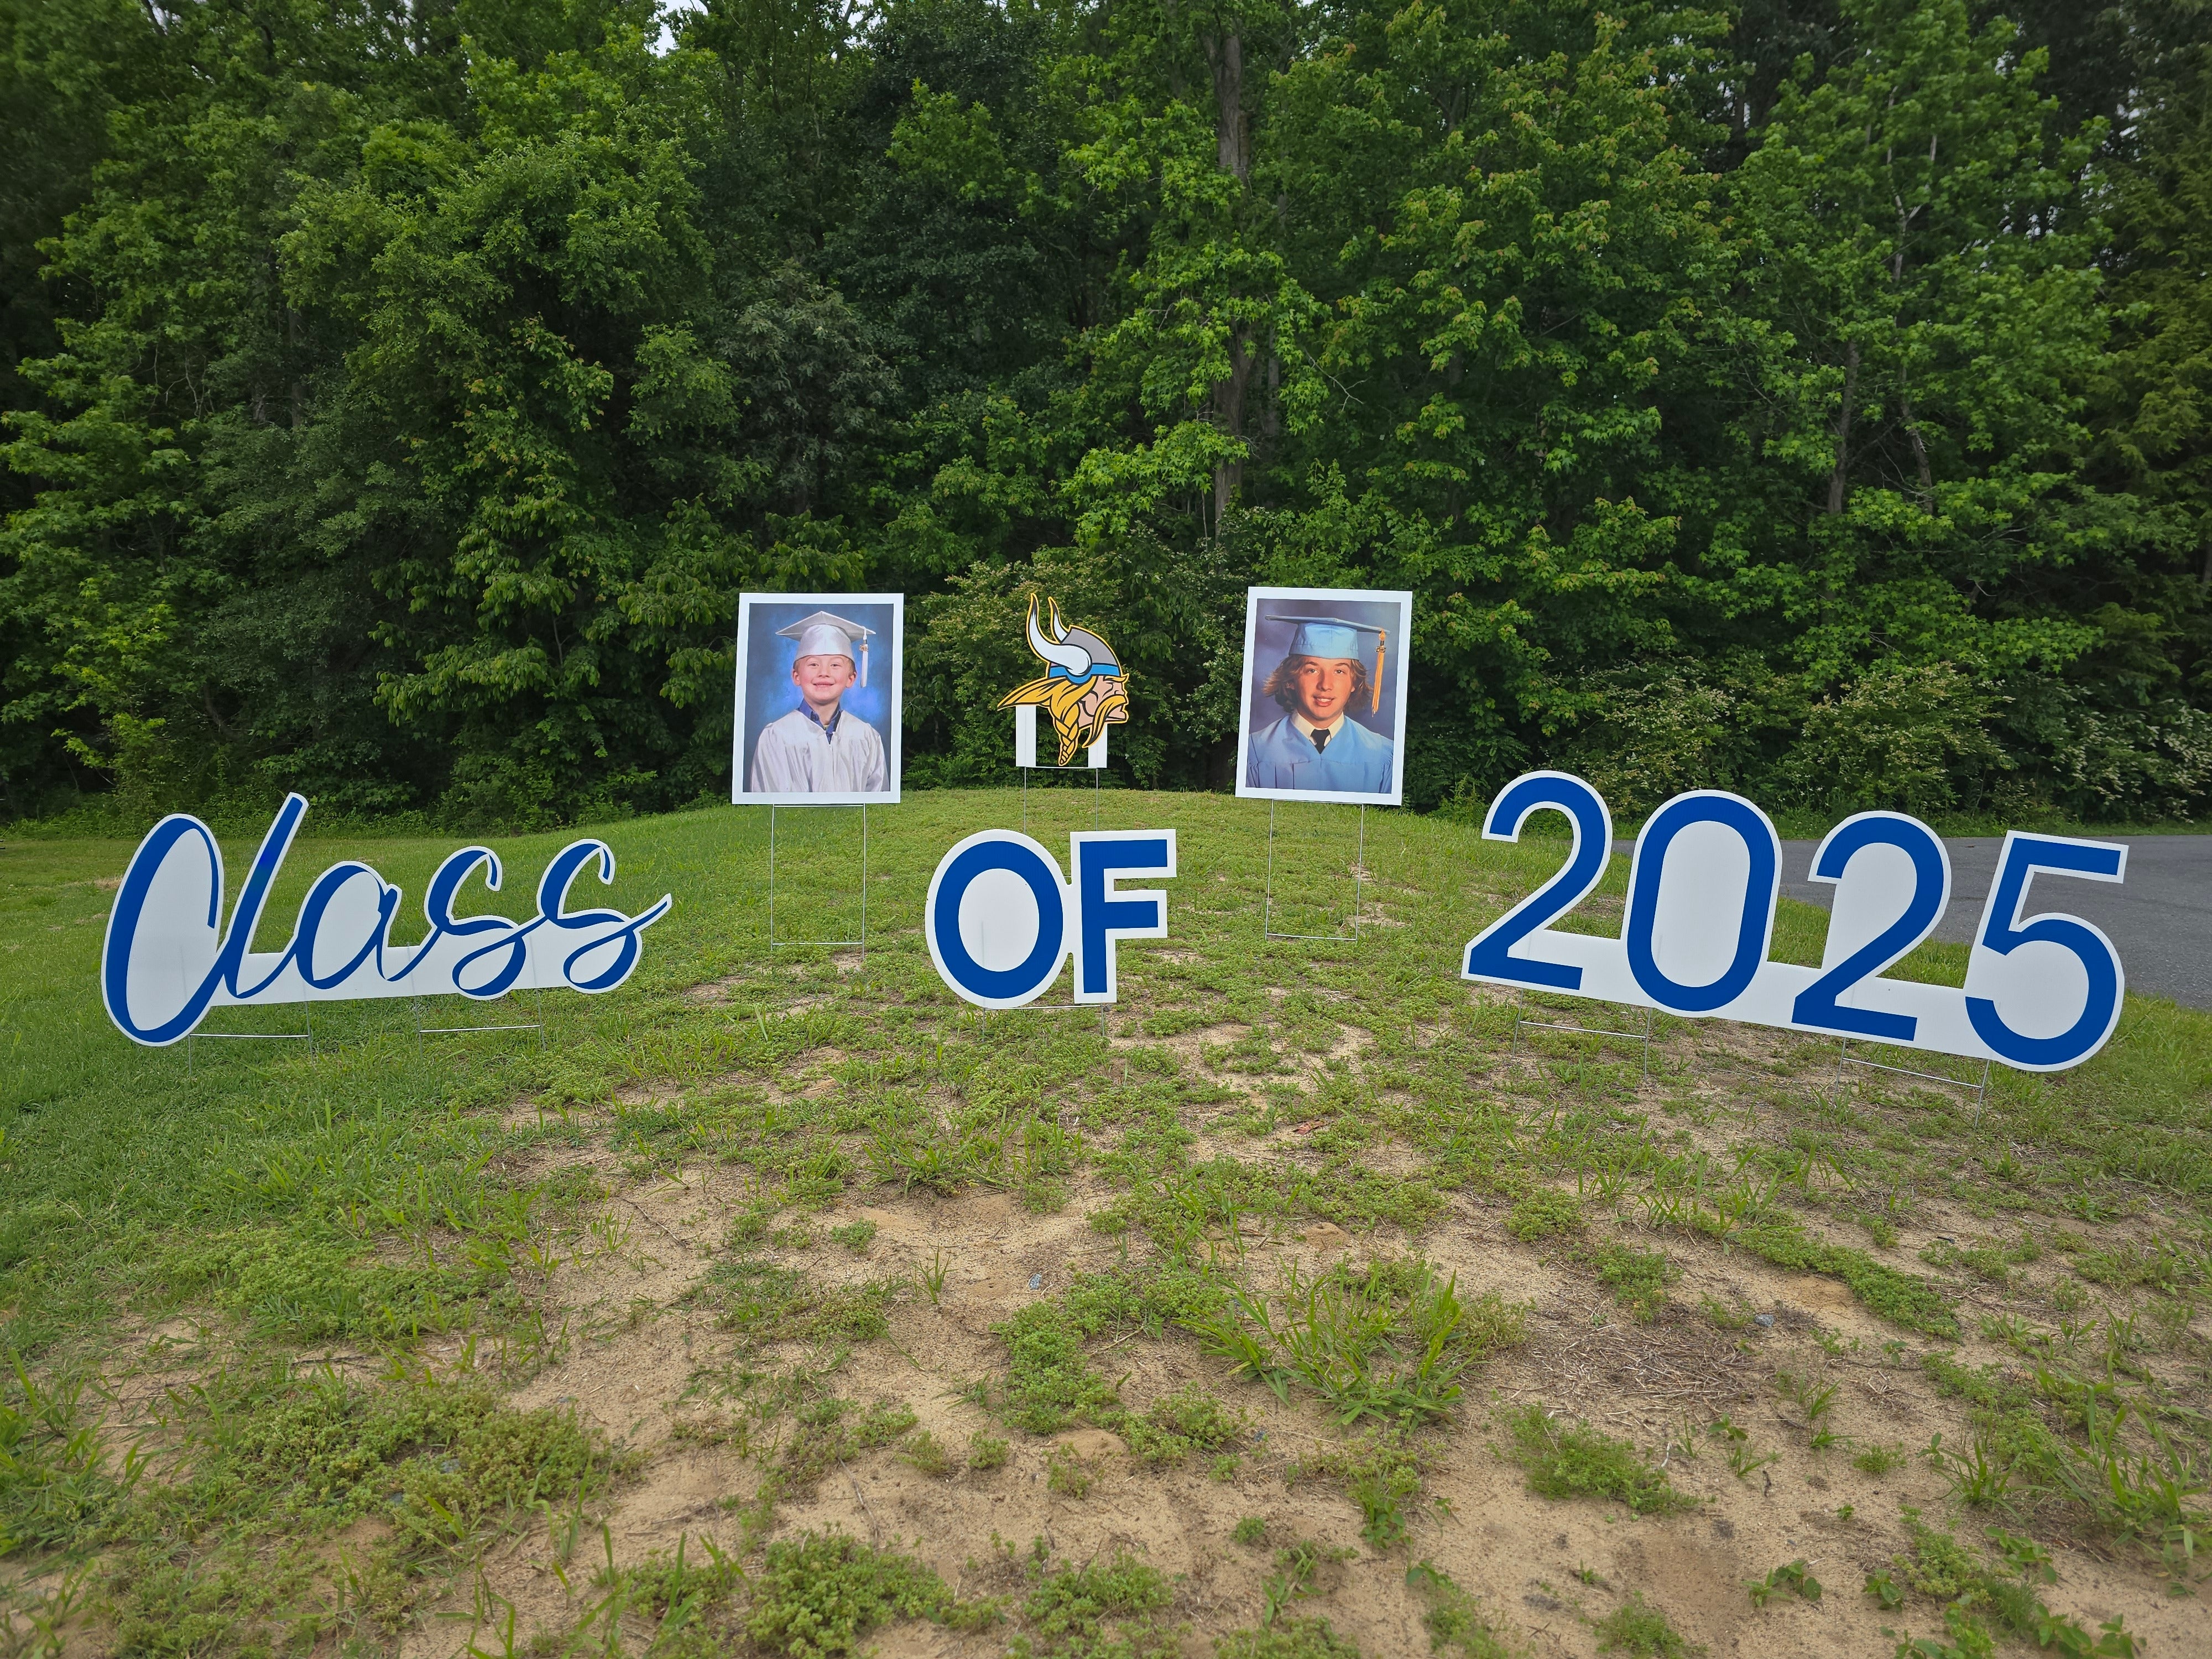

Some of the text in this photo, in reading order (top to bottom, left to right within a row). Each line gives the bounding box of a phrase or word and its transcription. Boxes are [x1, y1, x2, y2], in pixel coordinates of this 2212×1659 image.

[105, 796, 667, 1042] Class
[935, 839, 1167, 999] OF
[1468, 778, 2120, 1065] 2025
